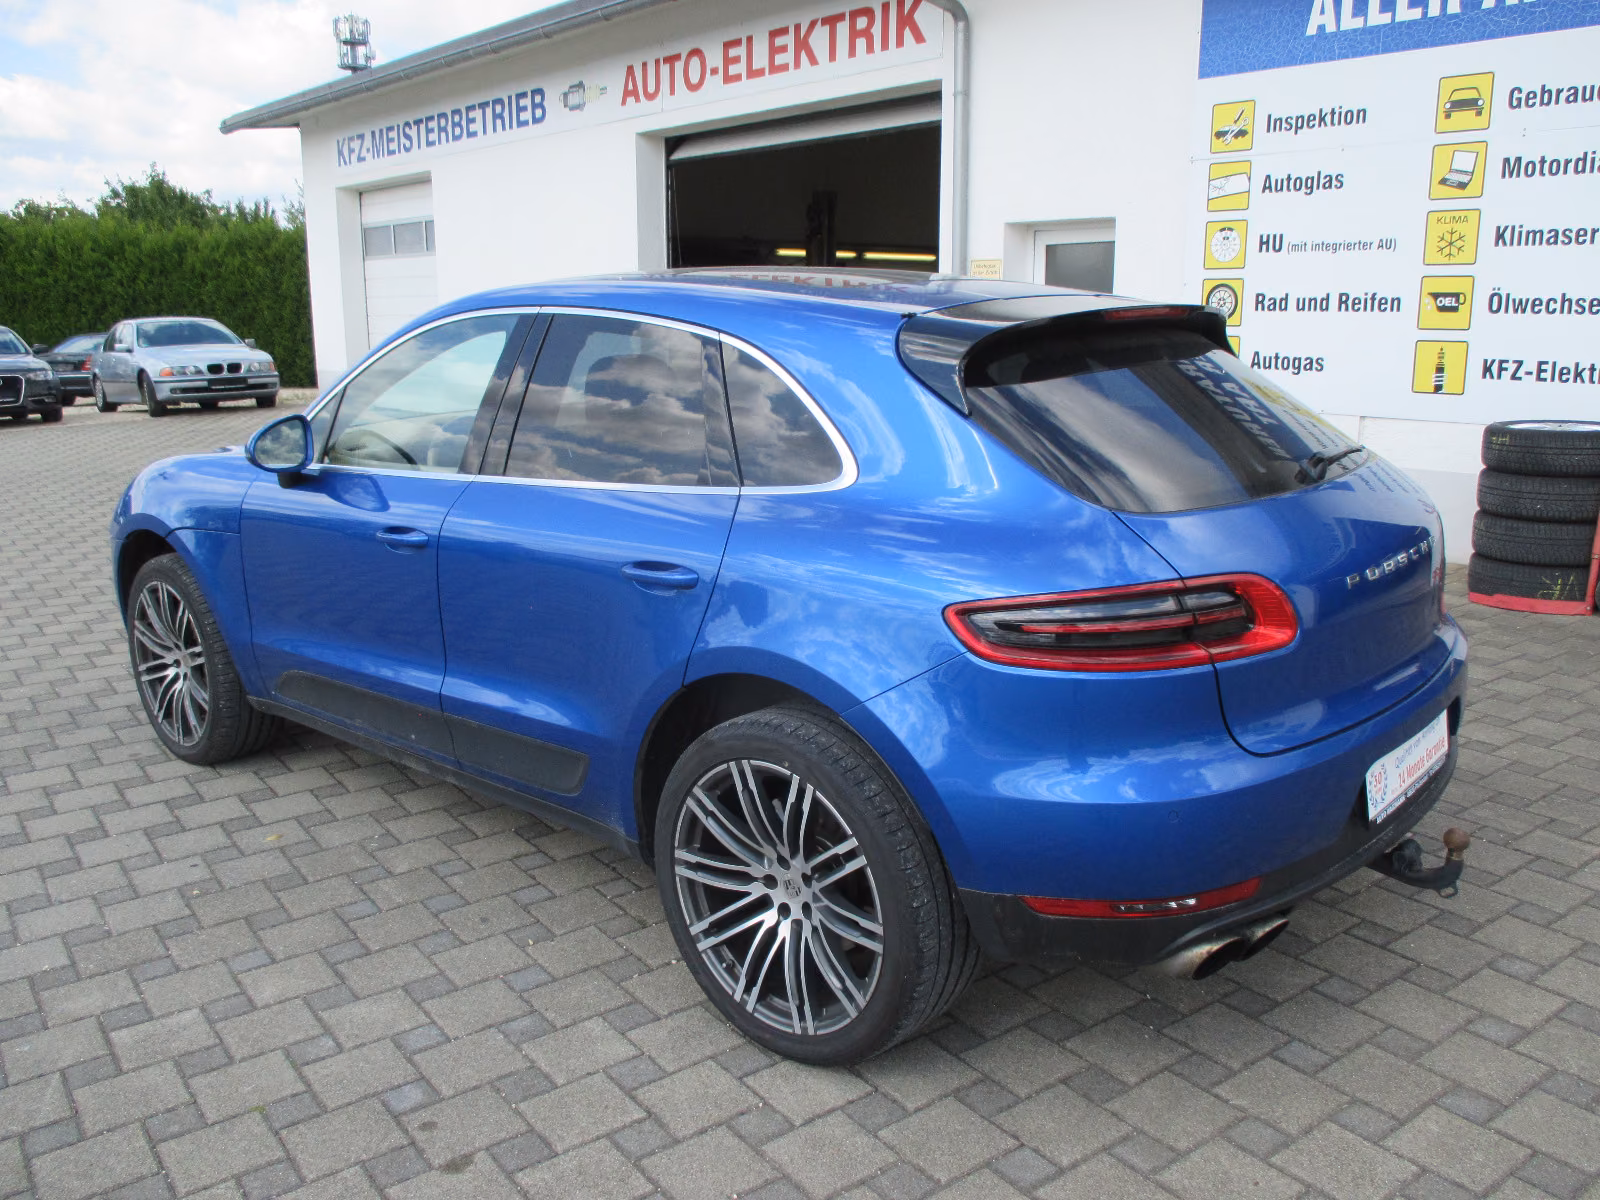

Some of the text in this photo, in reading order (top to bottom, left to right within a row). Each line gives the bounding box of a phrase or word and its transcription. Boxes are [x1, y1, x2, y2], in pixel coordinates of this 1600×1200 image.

[621, 0, 926, 106] AUTO-ELEKTRIK
[1508, 84, 1600, 110] Gebrau
[337, 87, 547, 168] KFZ-MEISTERBETRIEB
[1266, 105, 1367, 135] Inspektion
[1501, 150, 1600, 179] Motordi
[1261, 171, 1345, 195] Autoglas
[1436, 215, 1469, 224] KLIMA
[1258, 233, 1397, 254] HU (mit integrierter AU)
[1254, 292, 1402, 313] Rad und Reifen
[1437, 297, 1458, 306] OEL
[1250, 351, 1325, 375] Autogas
[1481, 358, 1600, 385] KFZ-Elekt
